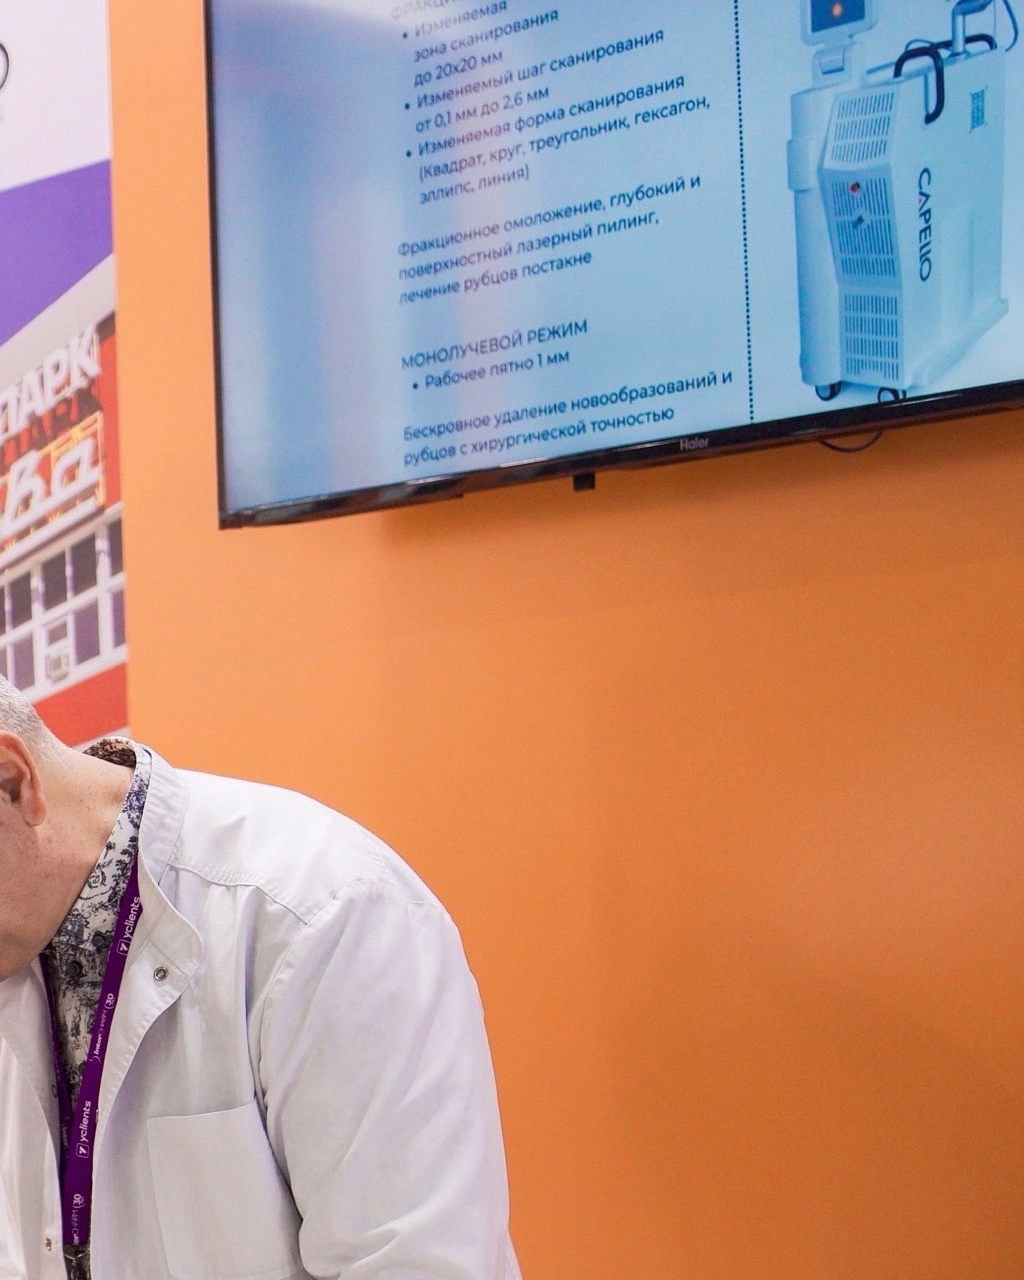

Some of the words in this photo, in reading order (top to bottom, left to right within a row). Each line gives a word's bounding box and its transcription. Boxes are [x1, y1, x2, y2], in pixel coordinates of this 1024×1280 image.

[413, 42, 447, 63] зона
[450, 9, 559, 51] сканирования
[415, 1, 508, 37] Изменяемая
[413, 71, 433, 88] до
[481, 51, 504, 66] мм
[416, 71, 514, 109] Изменяемый
[517, 62, 547, 82] шаг
[549, 29, 665, 72] сканирования
[415, 119, 432, 133] от
[434, 112, 451, 129] 0,1
[455, 107, 476, 122] мм
[480, 101, 499, 118] до
[502, 91, 524, 110] 2,6
[527, 87, 550, 103] мм
[418, 122, 511, 156] Изменяемая
[514, 108, 565, 133] форма
[569, 75, 685, 117] сканирования
[419, 153, 486, 182] (Квадрат,
[489, 143, 526, 163] круг,
[529, 116, 631, 153] треугольник,
[634, 96, 711, 125] гексагон,
[478, 163, 530, 191] линия)
[398, 222, 500, 257] Фракционное
[504, 199, 607, 233] омоложение,
[610, 176, 686, 208] глубокий
[690, 175, 701, 189] и
[918, 167, 932, 283] CAPELLO
[399, 243, 513, 280] поверхностный
[516, 223, 593, 254] лазерный
[597, 211, 660, 236] пилинг,
[399, 280, 460, 304] лечение
[463, 267, 518, 293] рубцов
[522, 251, 593, 278] постакне
[401, 331, 523, 370] МОНОЛУЧЕВОЙ
[527, 319, 588, 345] РЕЖИМ
[425, 366, 486, 390] Рабочее
[490, 357, 534, 377] пятно
[537, 353, 543, 367] 1
[547, 350, 570, 365] мм
[403, 414, 491, 441] Бескровное
[493, 401, 568, 428] удаление
[571, 371, 718, 411] новообразований
[722, 370, 733, 384] и
[404, 444, 456, 467] рубцов
[459, 444, 468, 455] с
[471, 419, 587, 453] хирургической
[590, 407, 675, 432] точностью
[679, 437, 710, 451] Haier
[123, 896, 141, 939] yclients
[80, 1101, 92, 1142] yclients
